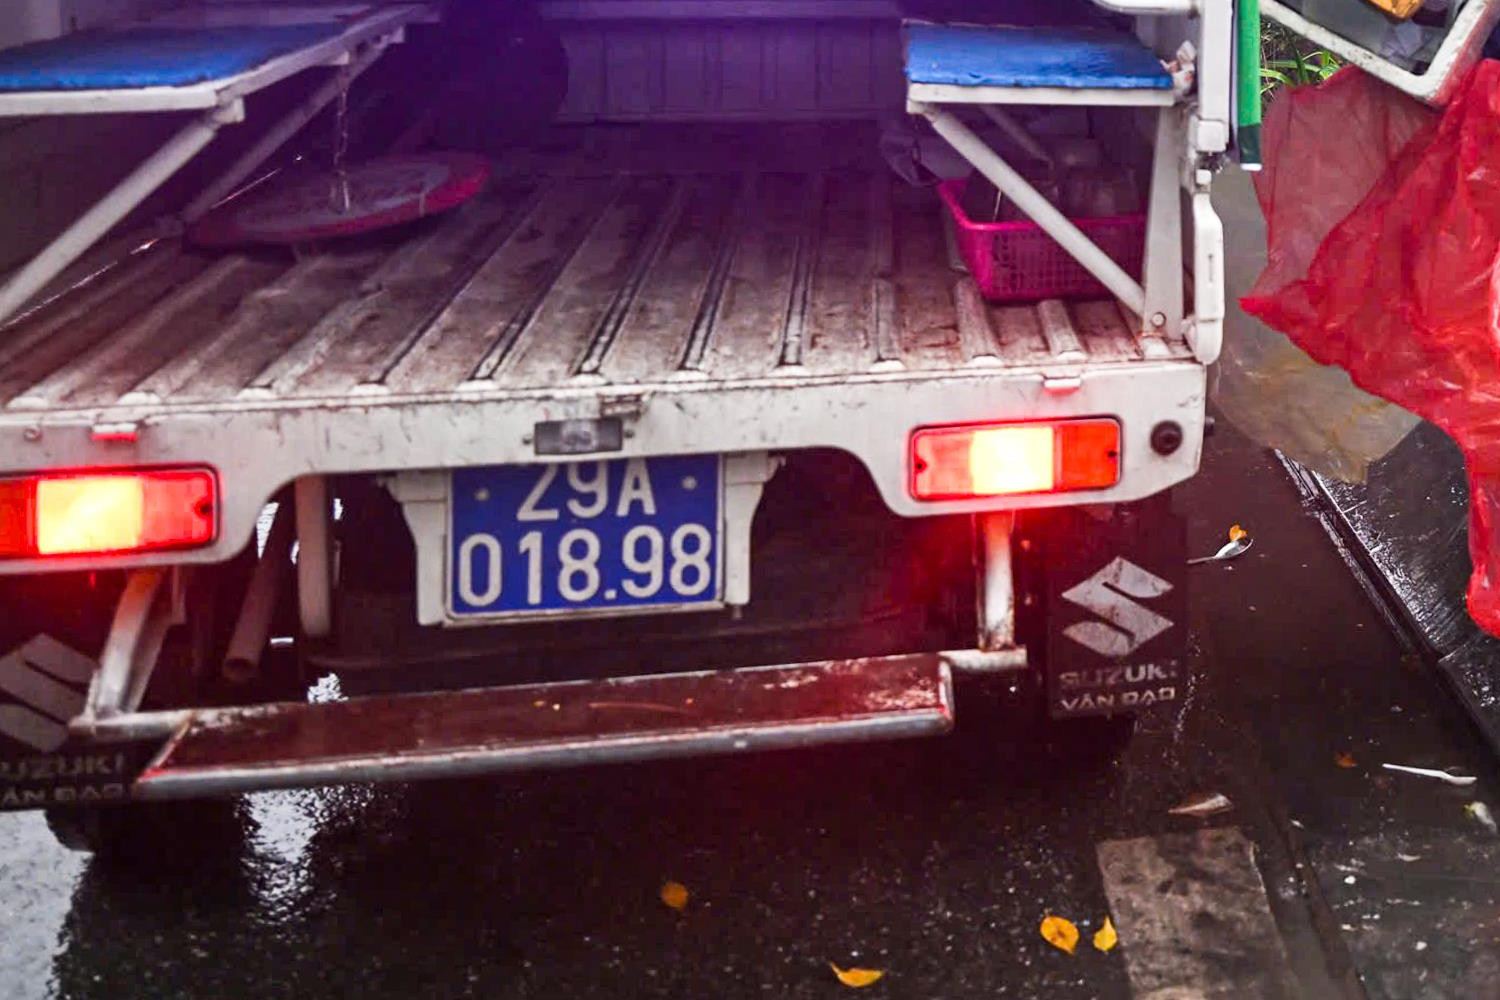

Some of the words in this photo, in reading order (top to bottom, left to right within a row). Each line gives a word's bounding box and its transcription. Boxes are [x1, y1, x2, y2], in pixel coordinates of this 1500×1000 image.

[517, 458, 656, 520] 29A
[459, 523, 712, 606] 018.98
[0, 752, 125, 781] UZUKI
